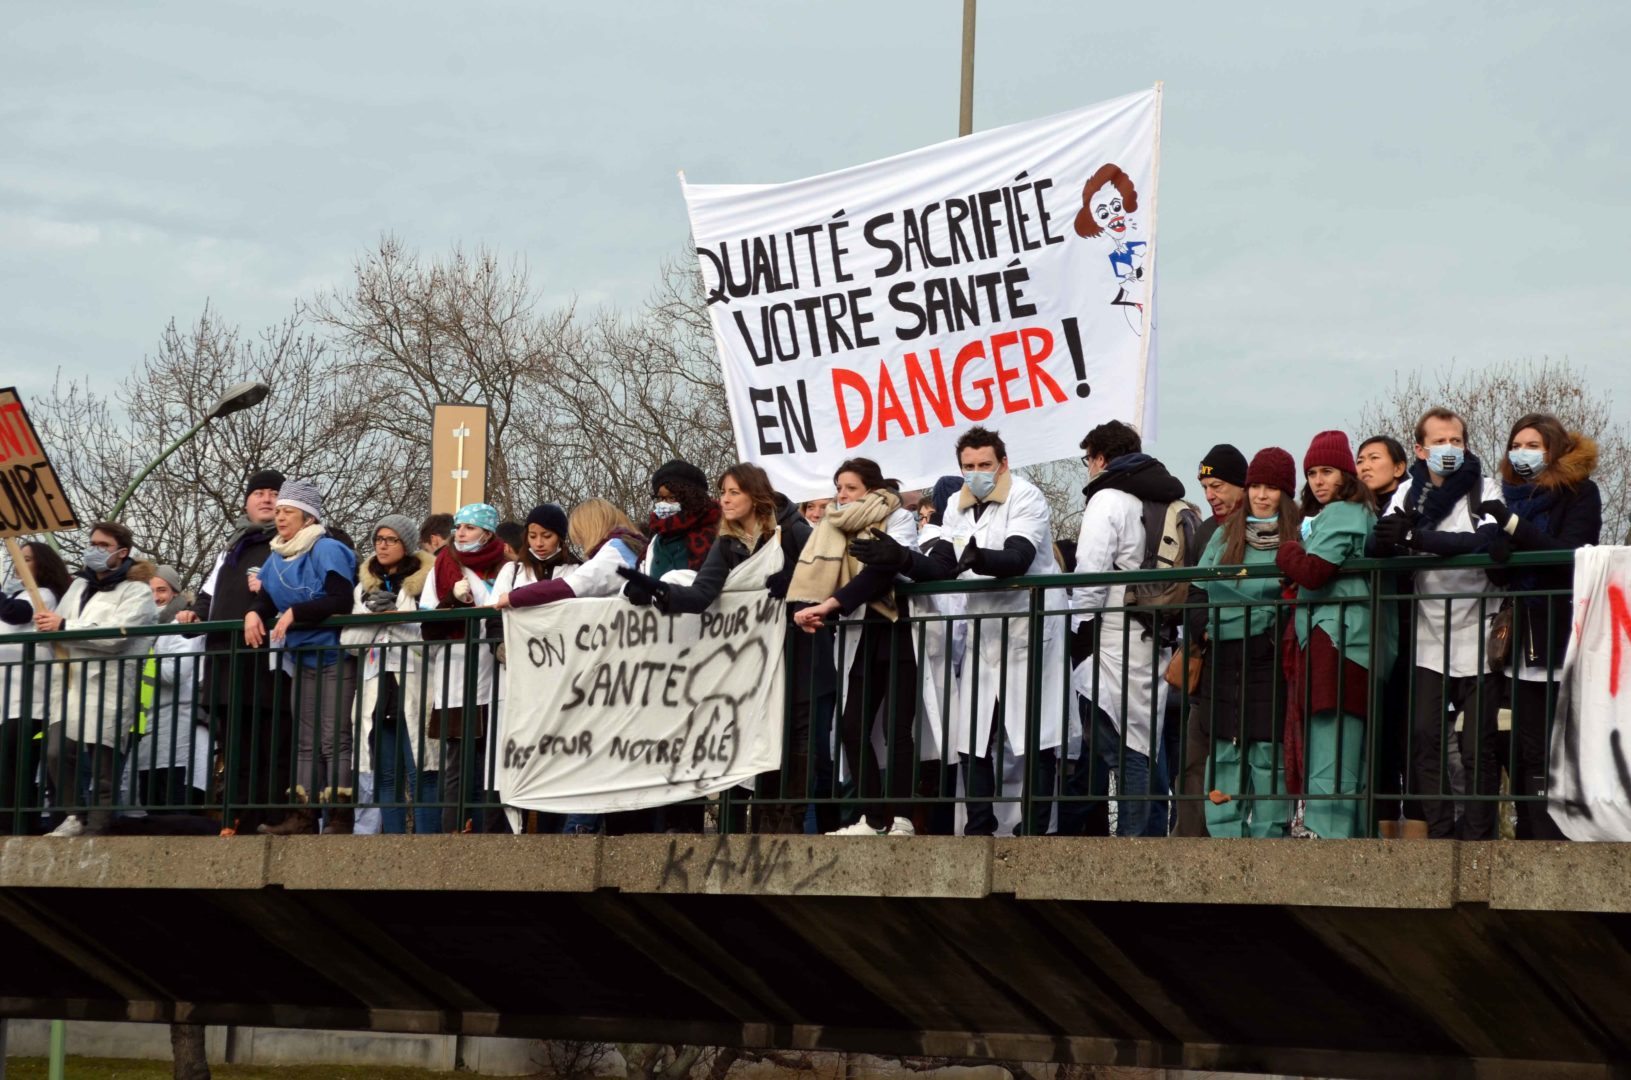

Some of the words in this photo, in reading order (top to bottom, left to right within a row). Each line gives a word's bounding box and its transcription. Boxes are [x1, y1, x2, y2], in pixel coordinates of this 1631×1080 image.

[696, 209, 853, 306] QUALITÉ
[864, 170, 1064, 278] SACRIFIÉE
[733, 286, 880, 366] VOTRE
[887, 258, 1037, 341] SANTÉ
[0, 402, 38, 463] NT
[748, 379, 817, 456] EN
[527, 633, 565, 668] ON
[700, 605, 749, 640] POUR
[560, 647, 690, 711] SANTÉ
[538, 729, 593, 759] POUR
[609, 736, 683, 764] NOTRE
